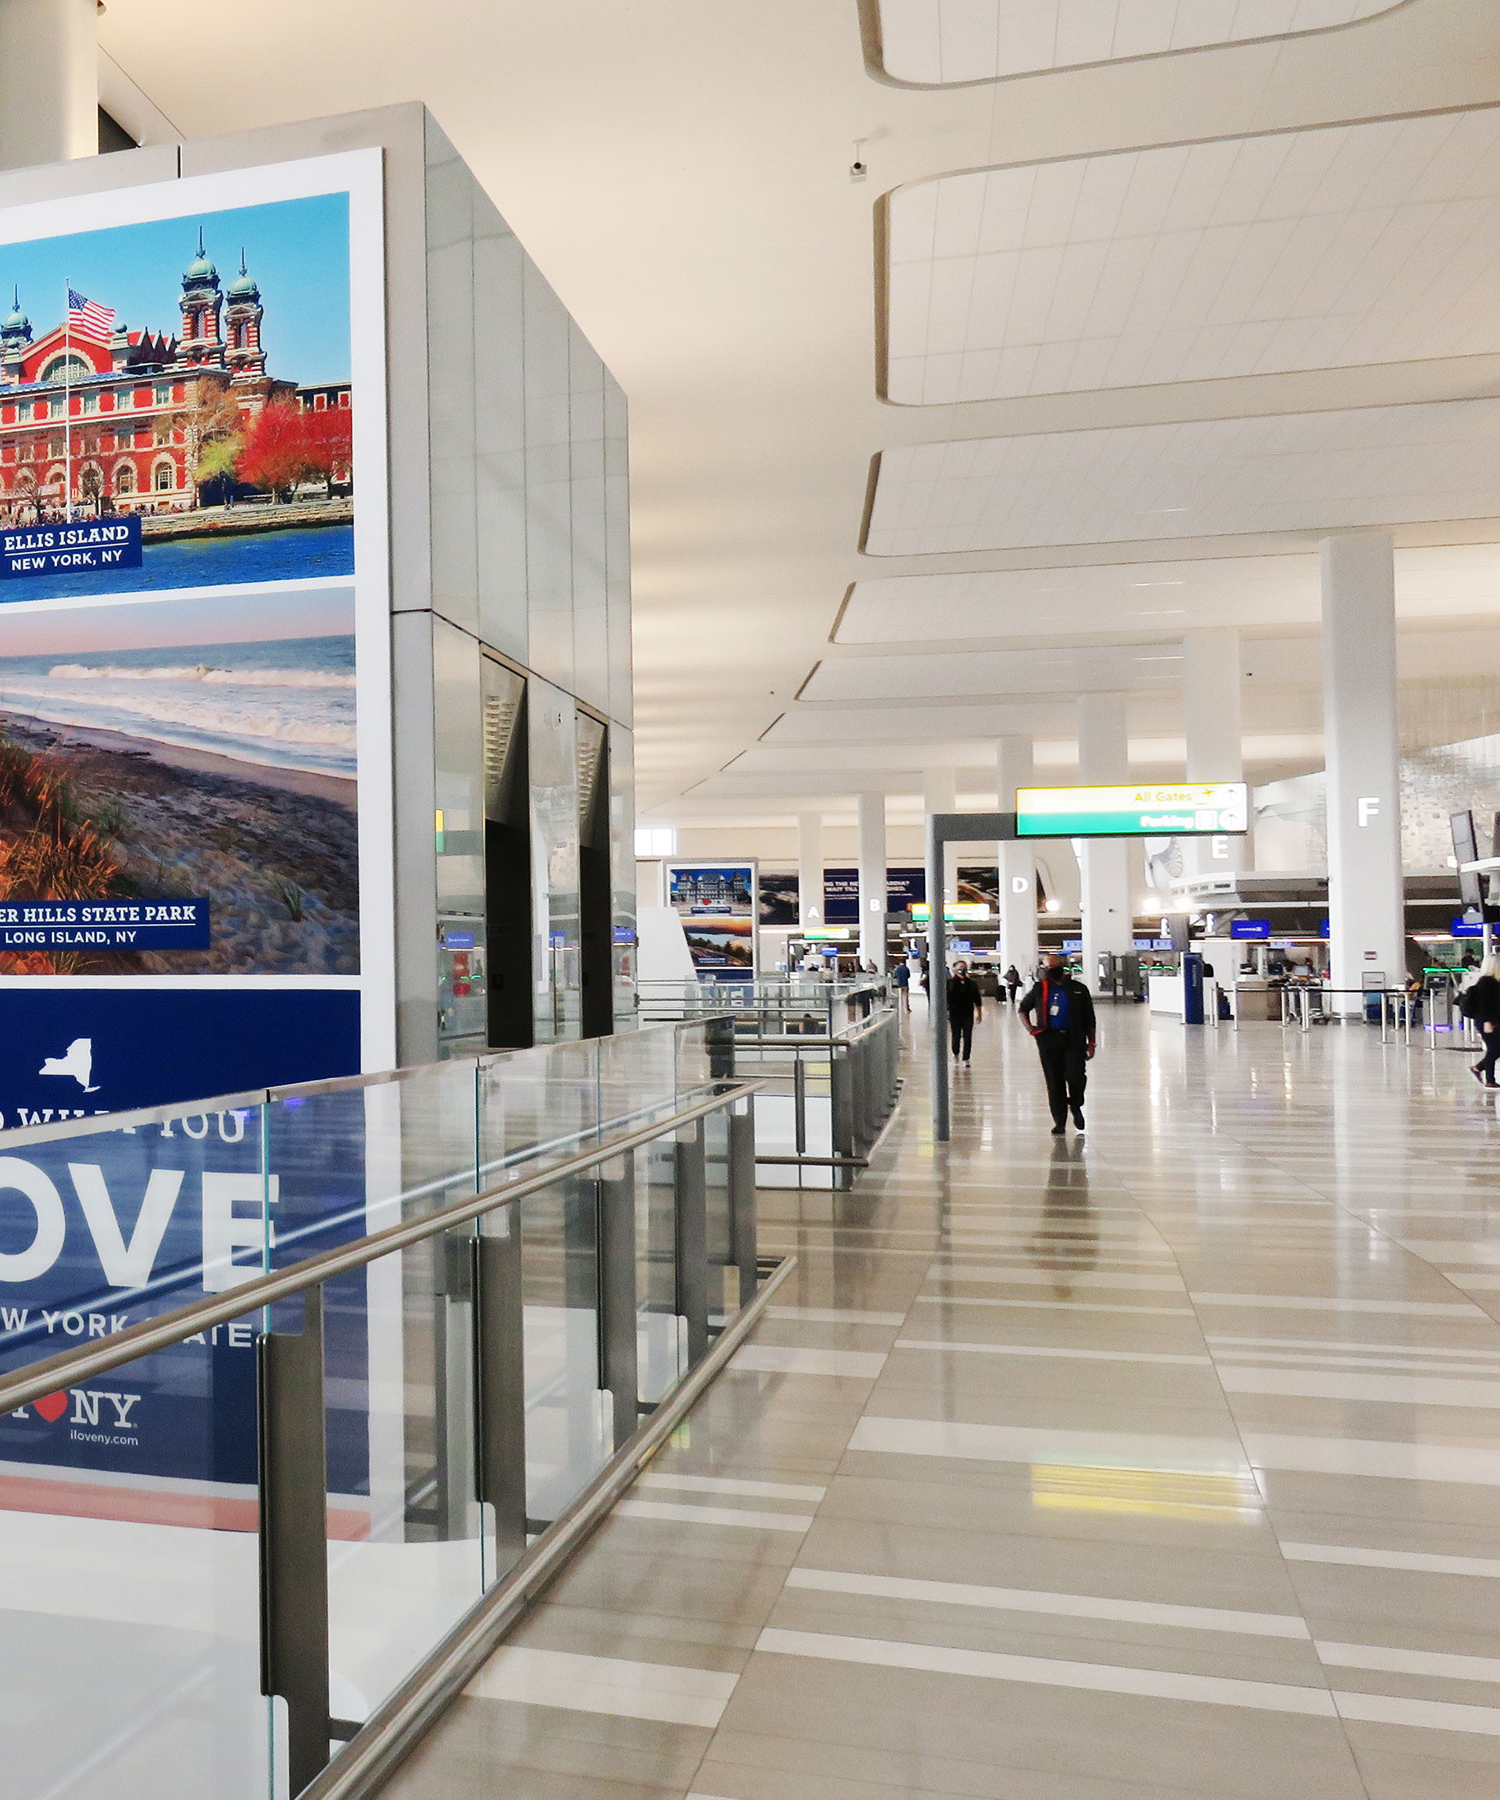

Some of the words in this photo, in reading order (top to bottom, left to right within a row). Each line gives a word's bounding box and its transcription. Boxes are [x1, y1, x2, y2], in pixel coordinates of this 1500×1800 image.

[4, 533, 54, 551] ELLIS
[59, 525, 129, 546] ISLAND
[11, 557, 46, 571] NEW
[51, 553, 97, 567] YORK,
[101, 549, 123, 563] NY
[1134, 792, 1151, 801] All
[1156, 791, 1192, 802] Gates
[1357, 797, 1380, 828] F
[1212, 836, 1230, 859] E
[1012, 876, 1029, 894] D
[23, 907, 76, 922] HILLS
[82, 906, 139, 921] STATE
[145, 905, 196, 920] PARK
[807, 906, 820, 919] A
[869, 898, 881, 912] B
[5, 932, 46, 943] LONG
[51, 931, 111, 944] ISLAND,
[116, 931, 137, 942] NY
[42, 1310, 129, 1337] YORK
[69, 1388, 142, 1428] NY
[70, 1429, 139, 1446] iloveny.com
